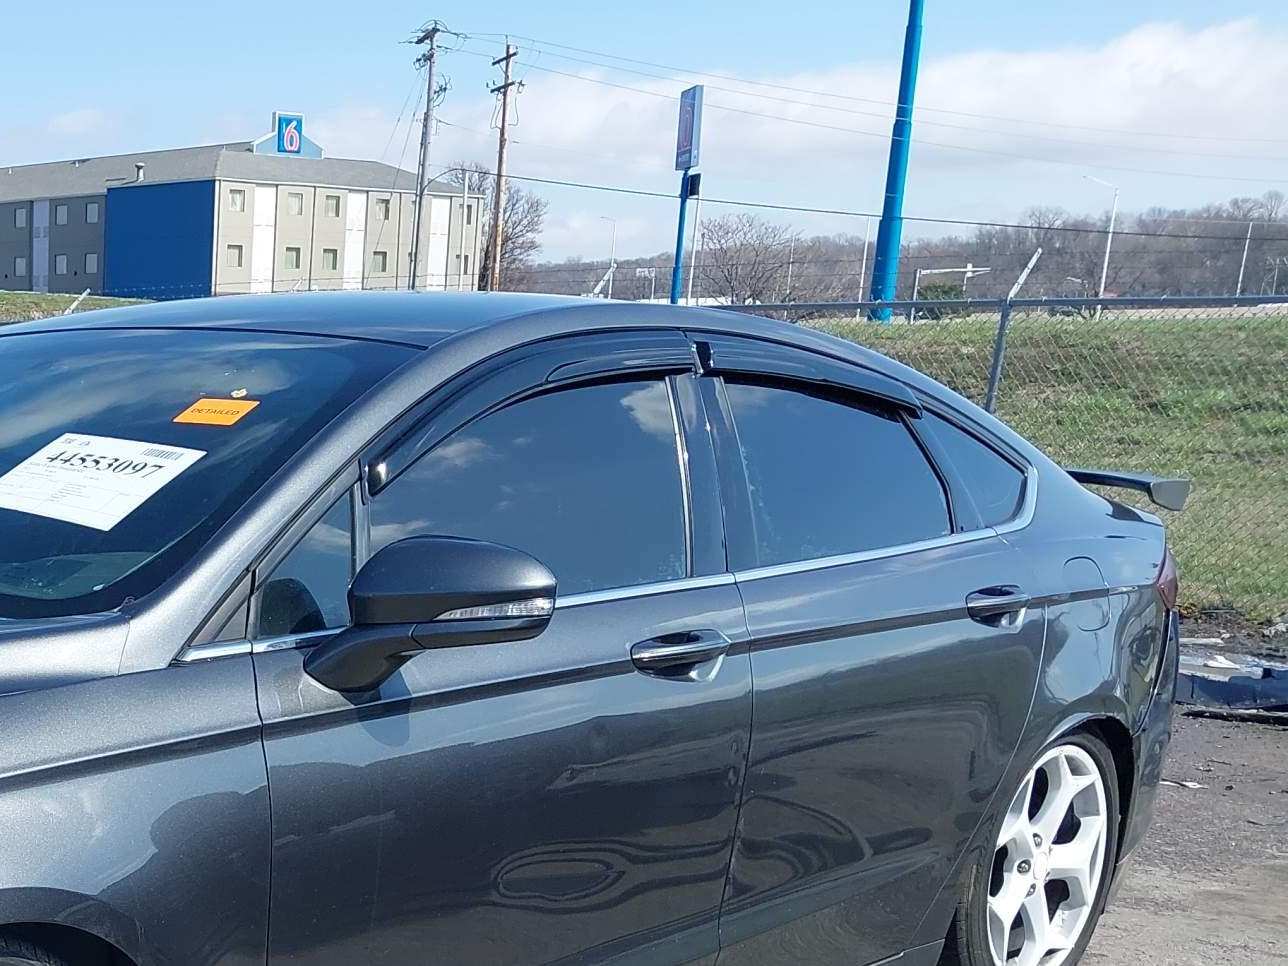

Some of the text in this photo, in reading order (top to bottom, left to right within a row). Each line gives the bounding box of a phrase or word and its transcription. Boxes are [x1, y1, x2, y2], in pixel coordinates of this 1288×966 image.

[284, 120, 299, 151] 6
[191, 408, 240, 416] DETAILED
[46, 450, 166, 478] 44553097
